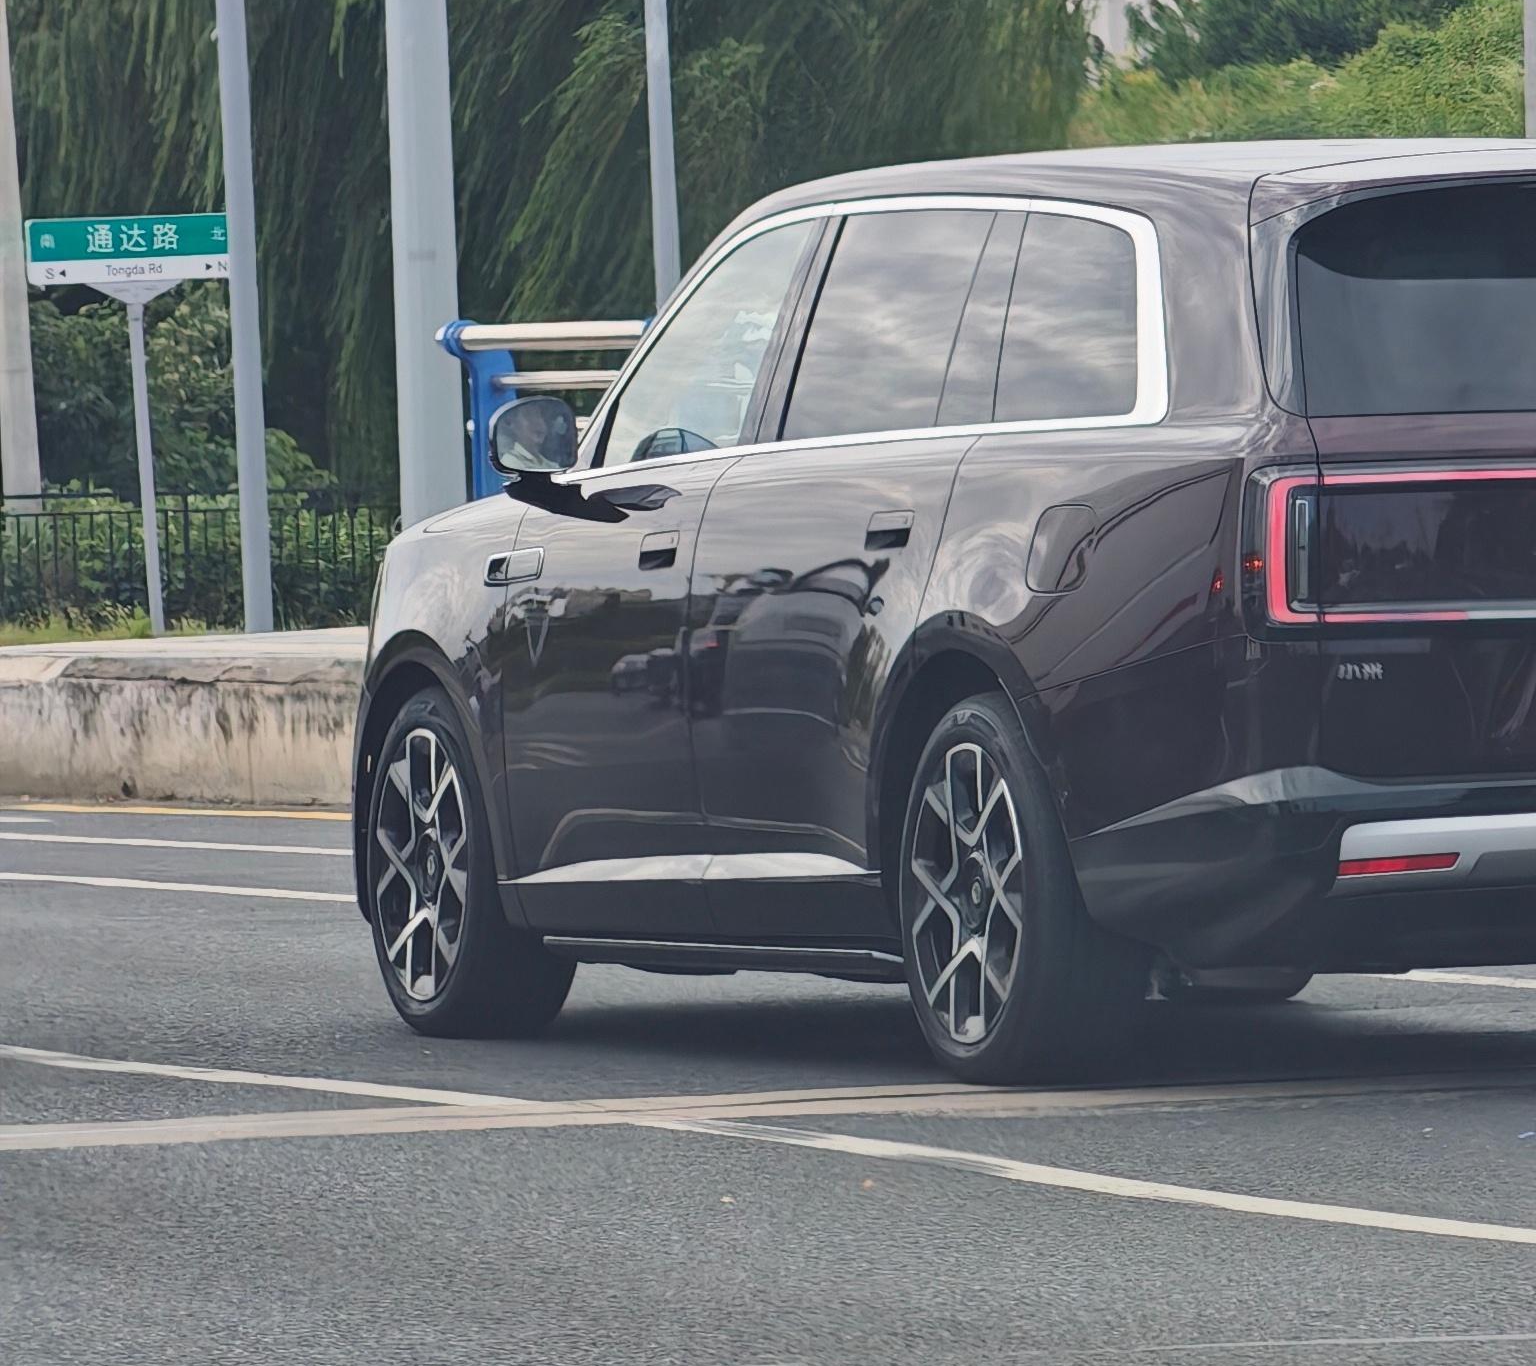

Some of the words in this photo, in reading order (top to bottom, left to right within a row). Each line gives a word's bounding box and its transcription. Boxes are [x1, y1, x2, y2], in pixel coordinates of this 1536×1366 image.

[86, 222, 179, 253] 通达路
[45, 268, 55, 280] S
[106, 263, 145, 278] Tongda
[149, 263, 163, 274] Rd
[218, 260, 227, 272] N
